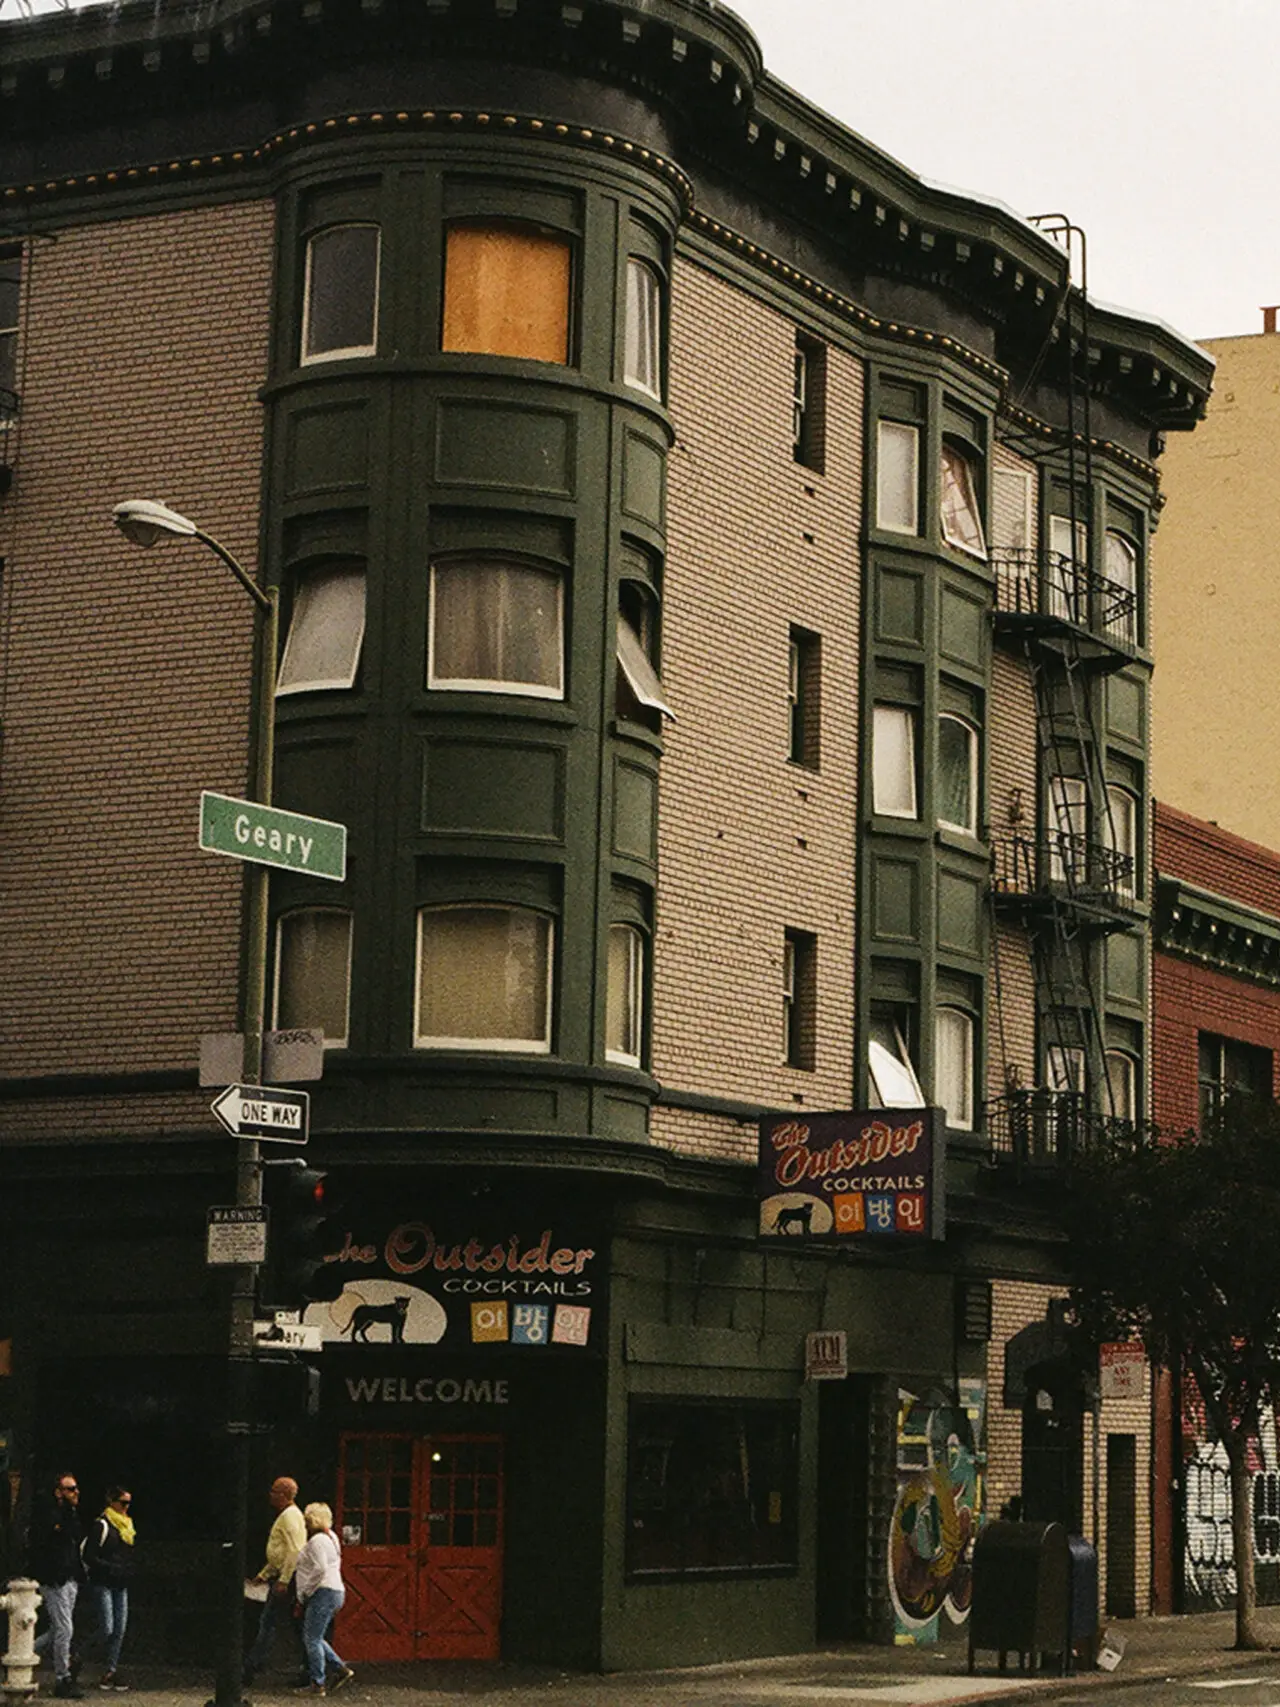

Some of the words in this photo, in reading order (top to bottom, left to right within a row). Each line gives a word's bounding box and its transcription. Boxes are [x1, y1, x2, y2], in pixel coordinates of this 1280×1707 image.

[234, 814, 313, 864] Geary
[241, 1102, 268, 1122] ONE
[272, 1105, 299, 1126] WAY
[771, 1120, 810, 1150] The
[775, 1119, 923, 1187] Outsider
[822, 1175, 925, 1191] COCKTAILS
[213, 1209, 262, 1221] WARNING
[838, 1198, 921, 1228] 이방인
[323, 1231, 378, 1263] he
[384, 1221, 596, 1275] Outsider
[442, 1278, 593, 1296] COCKTAILS
[345, 1377, 509, 1404] WELCOME
